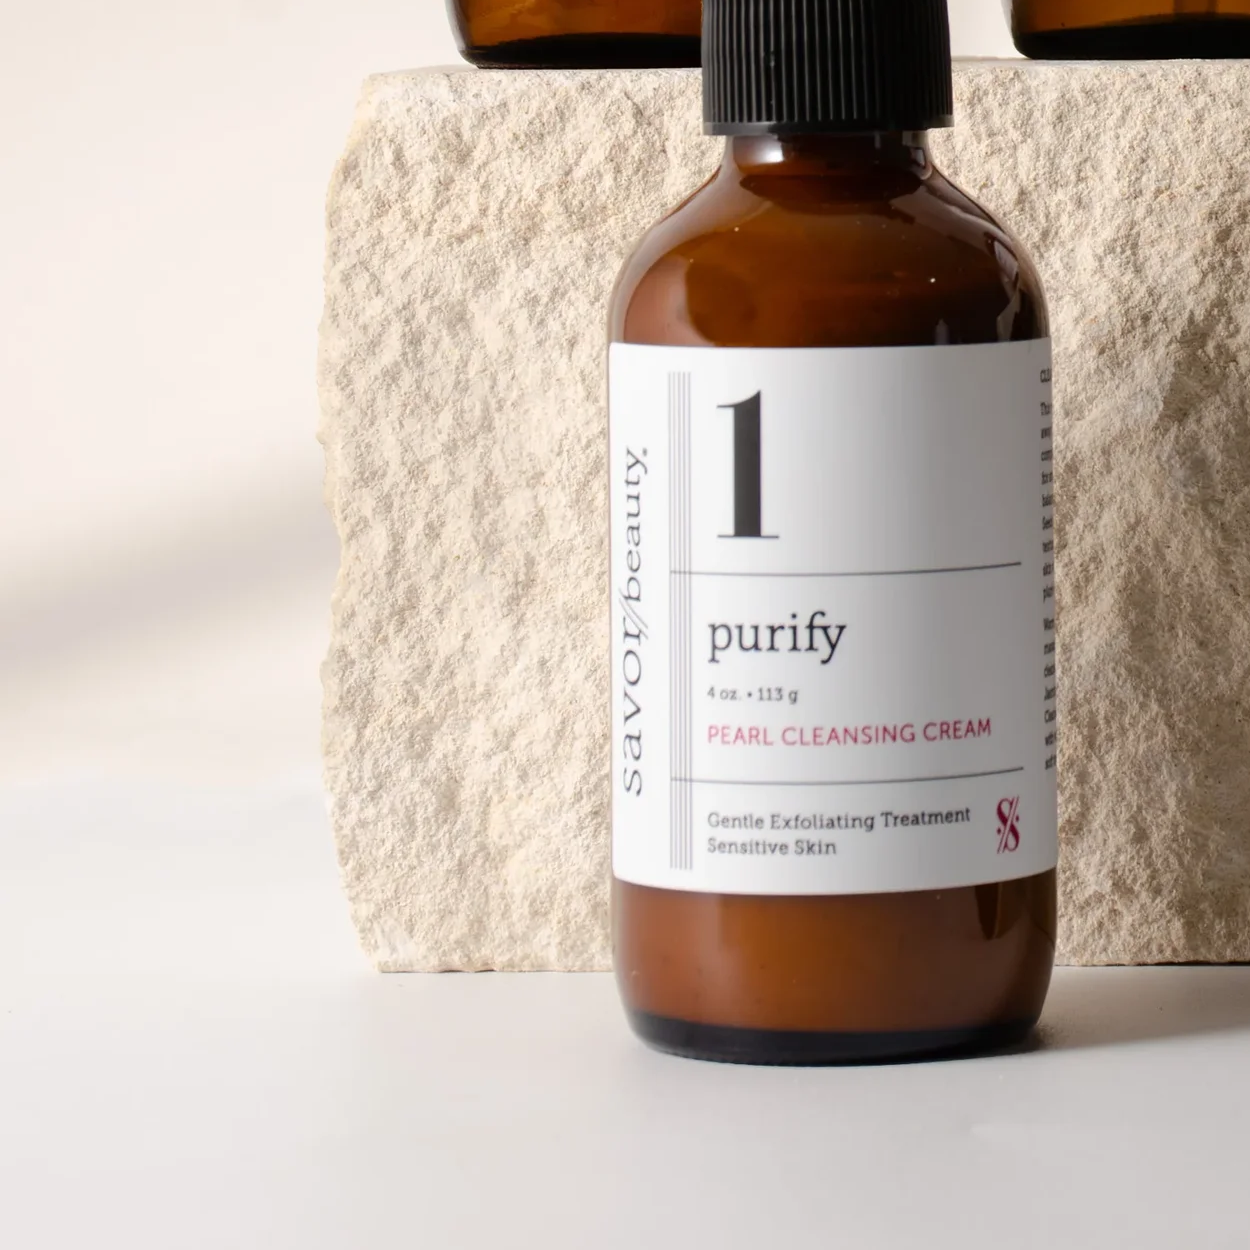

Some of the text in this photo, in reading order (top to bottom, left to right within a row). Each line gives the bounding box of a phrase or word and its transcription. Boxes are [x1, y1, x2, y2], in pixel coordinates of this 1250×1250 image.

[717, 390, 779, 538] 1
[707, 612, 847, 664] purify
[707, 687, 715, 700] 4
[758, 688, 784, 702] 113
[788, 690, 798, 704] g
[707, 718, 992, 746] PEARL CLEANSING CREAM
[708, 808, 970, 831] Gentle Exfoliating Treatment
[708, 838, 836, 856] Sensitive Skin
